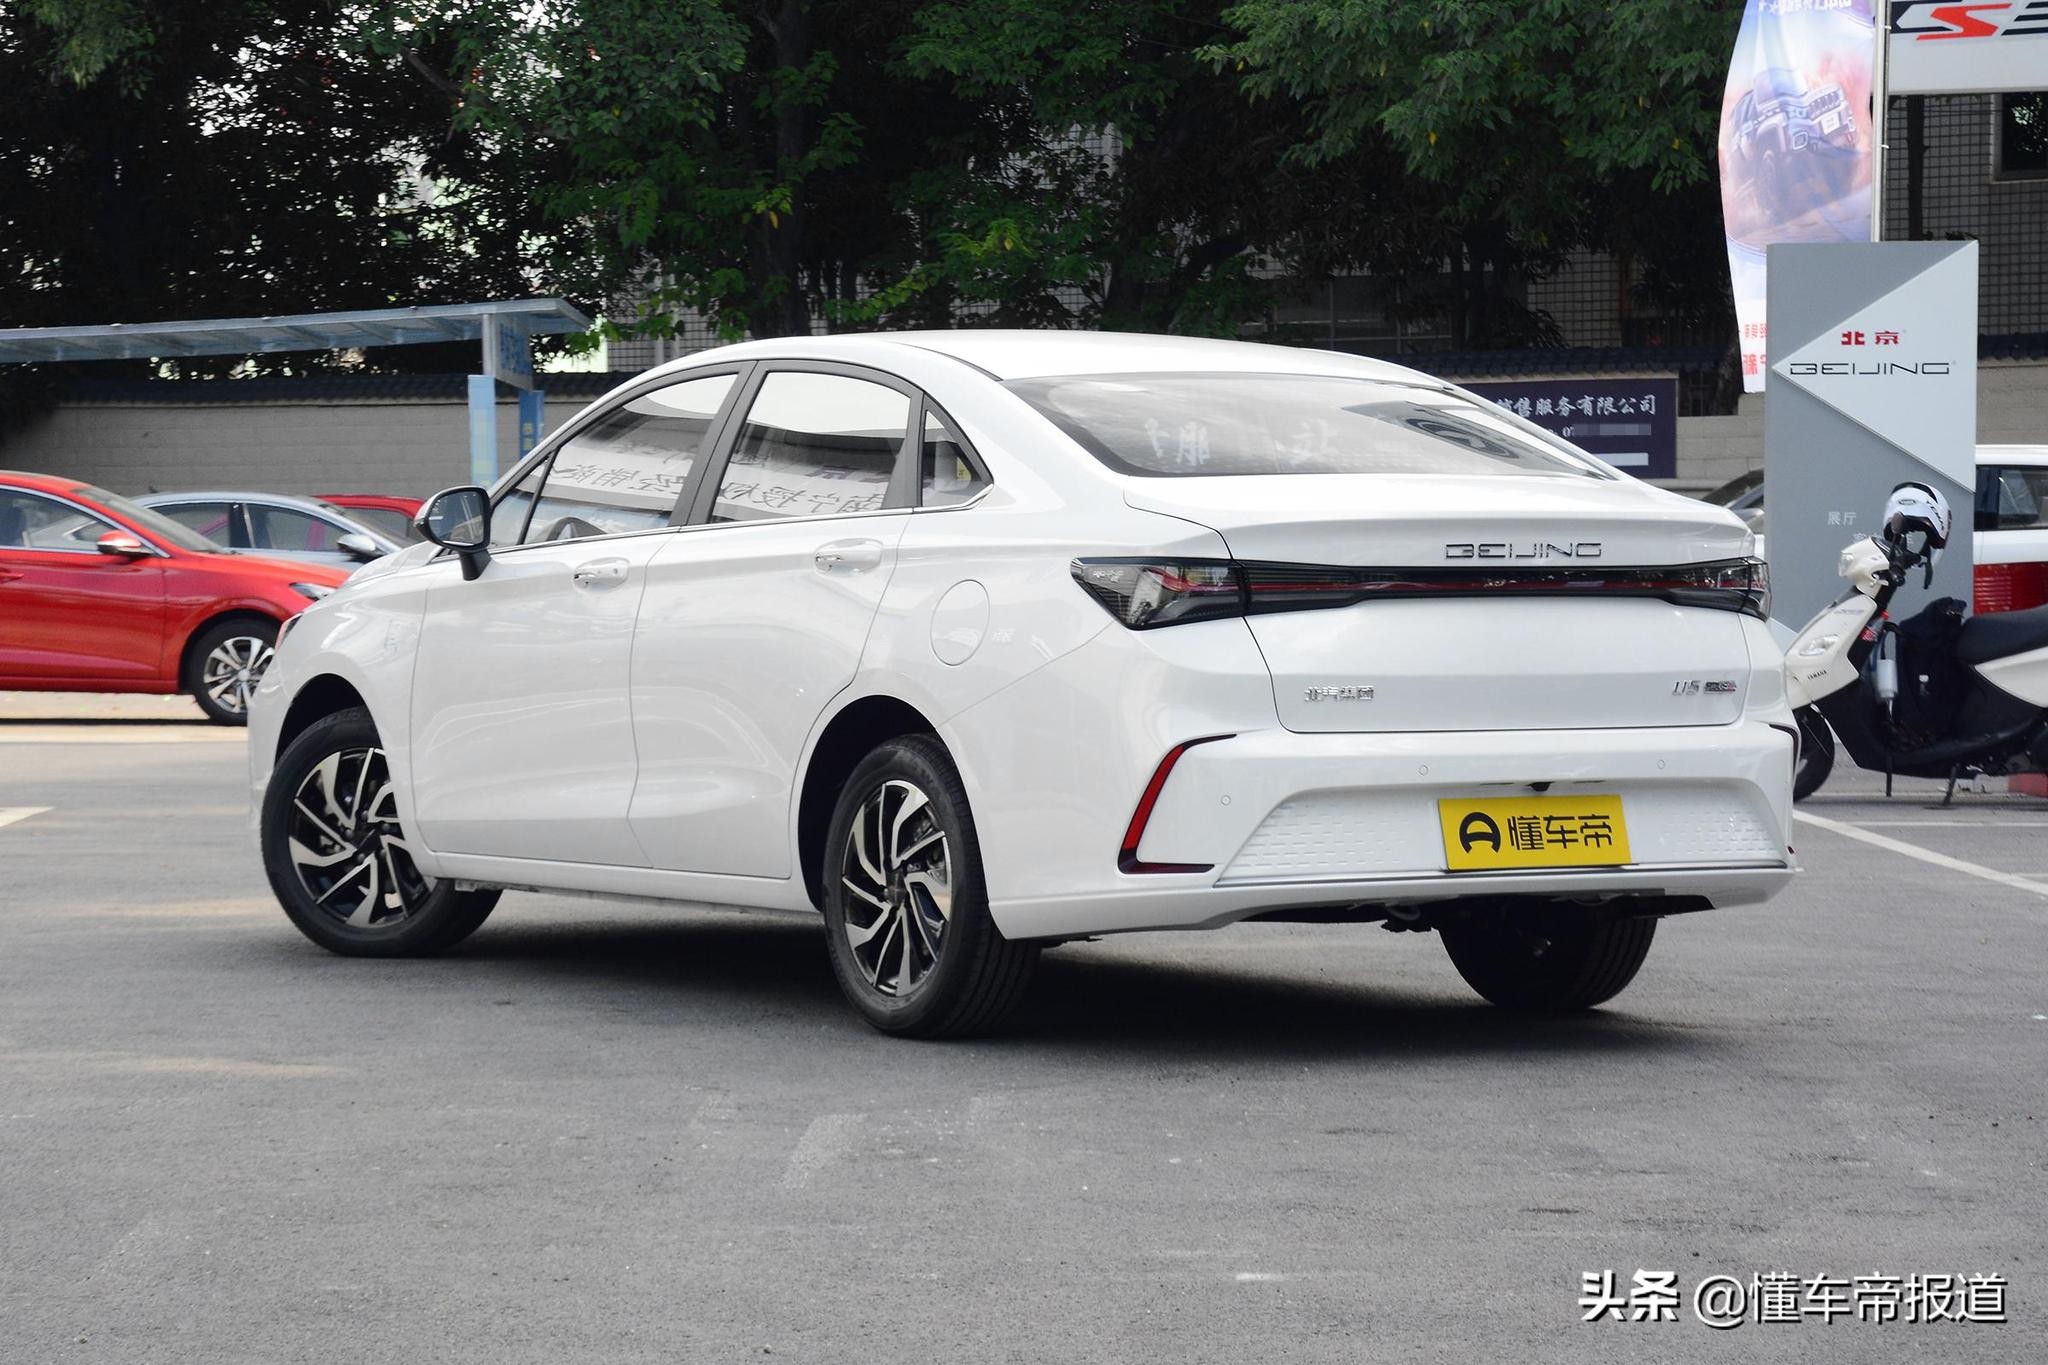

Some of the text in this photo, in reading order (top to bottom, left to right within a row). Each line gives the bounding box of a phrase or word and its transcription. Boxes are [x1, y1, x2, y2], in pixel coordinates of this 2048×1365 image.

[1841, 331, 1899, 346] 北京
[1790, 362, 1949, 375] BEIJING
[1828, 511, 1857, 526] 展厅
[1446, 543, 1602, 559] BEIJING
[1507, 813, 1613, 851] 懂车帝
